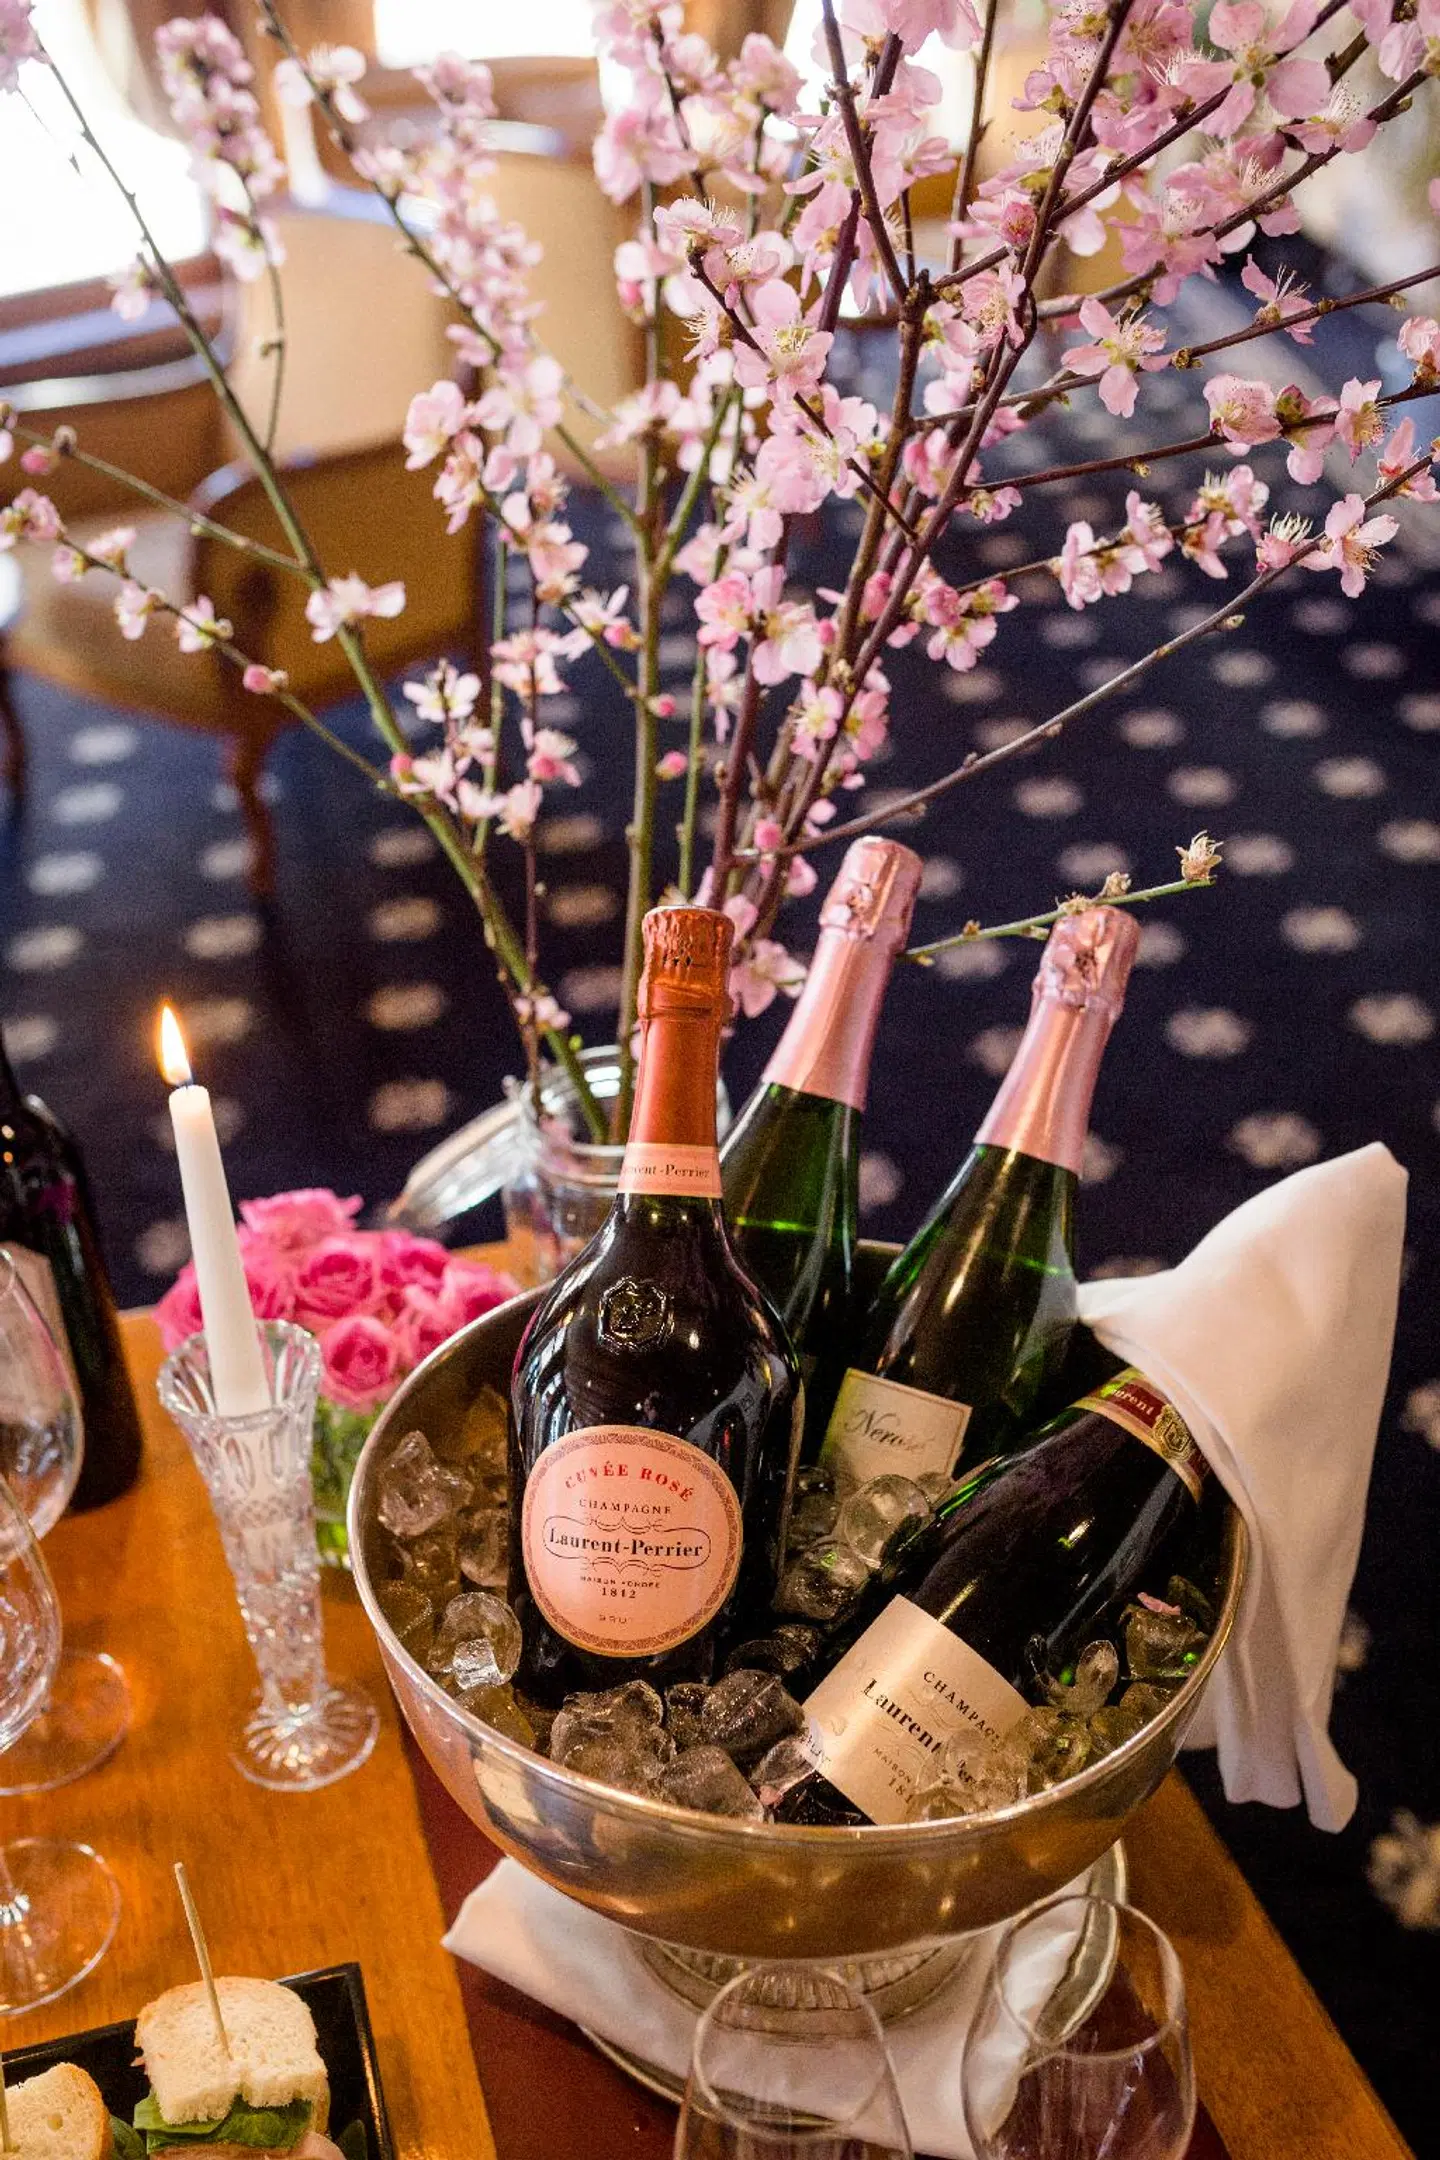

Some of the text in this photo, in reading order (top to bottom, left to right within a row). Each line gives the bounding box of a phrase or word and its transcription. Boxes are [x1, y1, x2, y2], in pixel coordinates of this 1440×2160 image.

[565, 1460, 695, 1502] CUVÉE ROSÉ
[579, 1498, 672, 1515] CHAMPAGNE
[549, 1527, 703, 1557] Laurent-Perrier
[602, 1587, 636, 1599] 1812
[888, 1777, 914, 1804] 181
